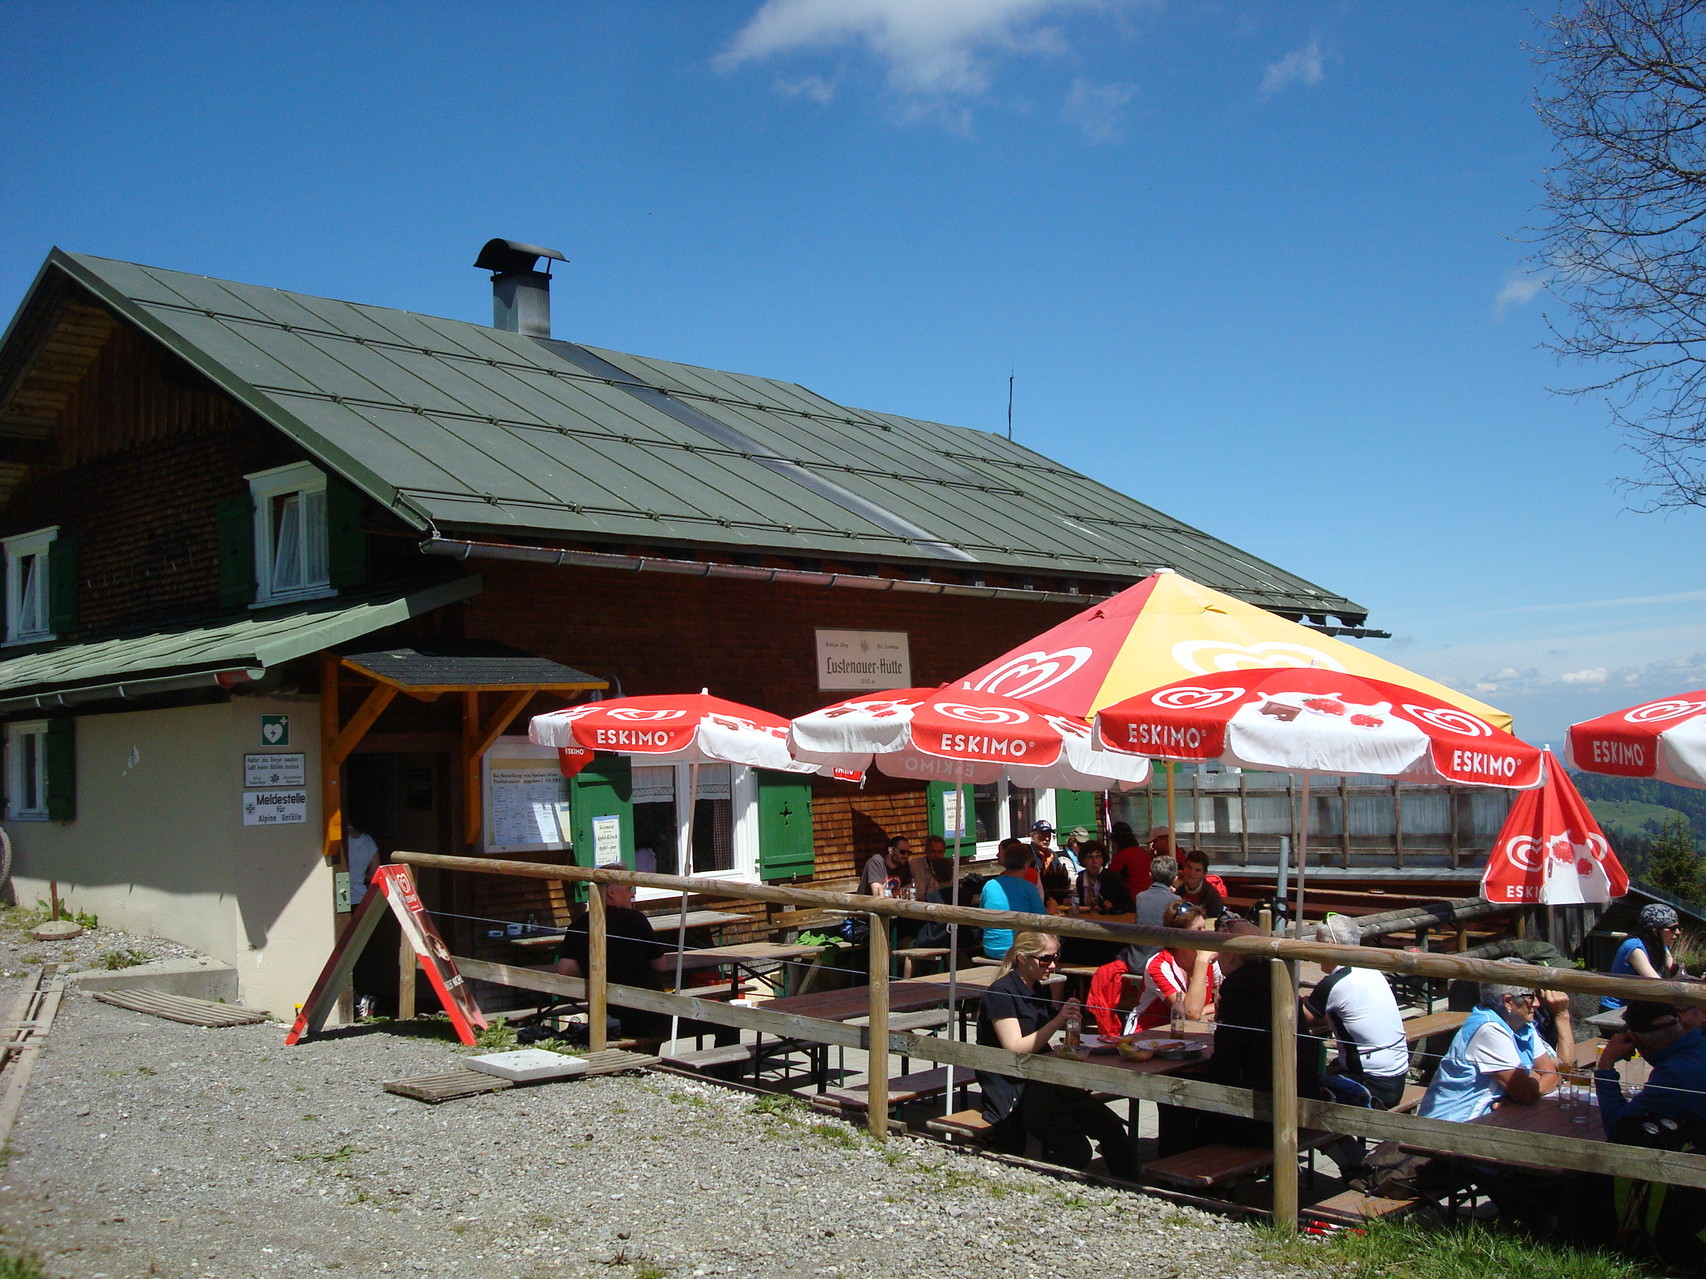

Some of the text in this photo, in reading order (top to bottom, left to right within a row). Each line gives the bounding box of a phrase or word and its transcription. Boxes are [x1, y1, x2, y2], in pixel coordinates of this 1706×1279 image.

[597, 729, 669, 746] ESKIMO
[1128, 723, 1200, 748] ESKIMO
[565, 747, 584, 756] ESKIMO
[941, 733, 1027, 757] ESKIMO
[1593, 740, 1644, 766] ESKIMO
[1453, 750, 1516, 777] ESKIMO
[257, 793, 305, 805] Meldestelle
[258, 812, 302, 823] Alpine Unfälle
[276, 805, 286, 813] für
